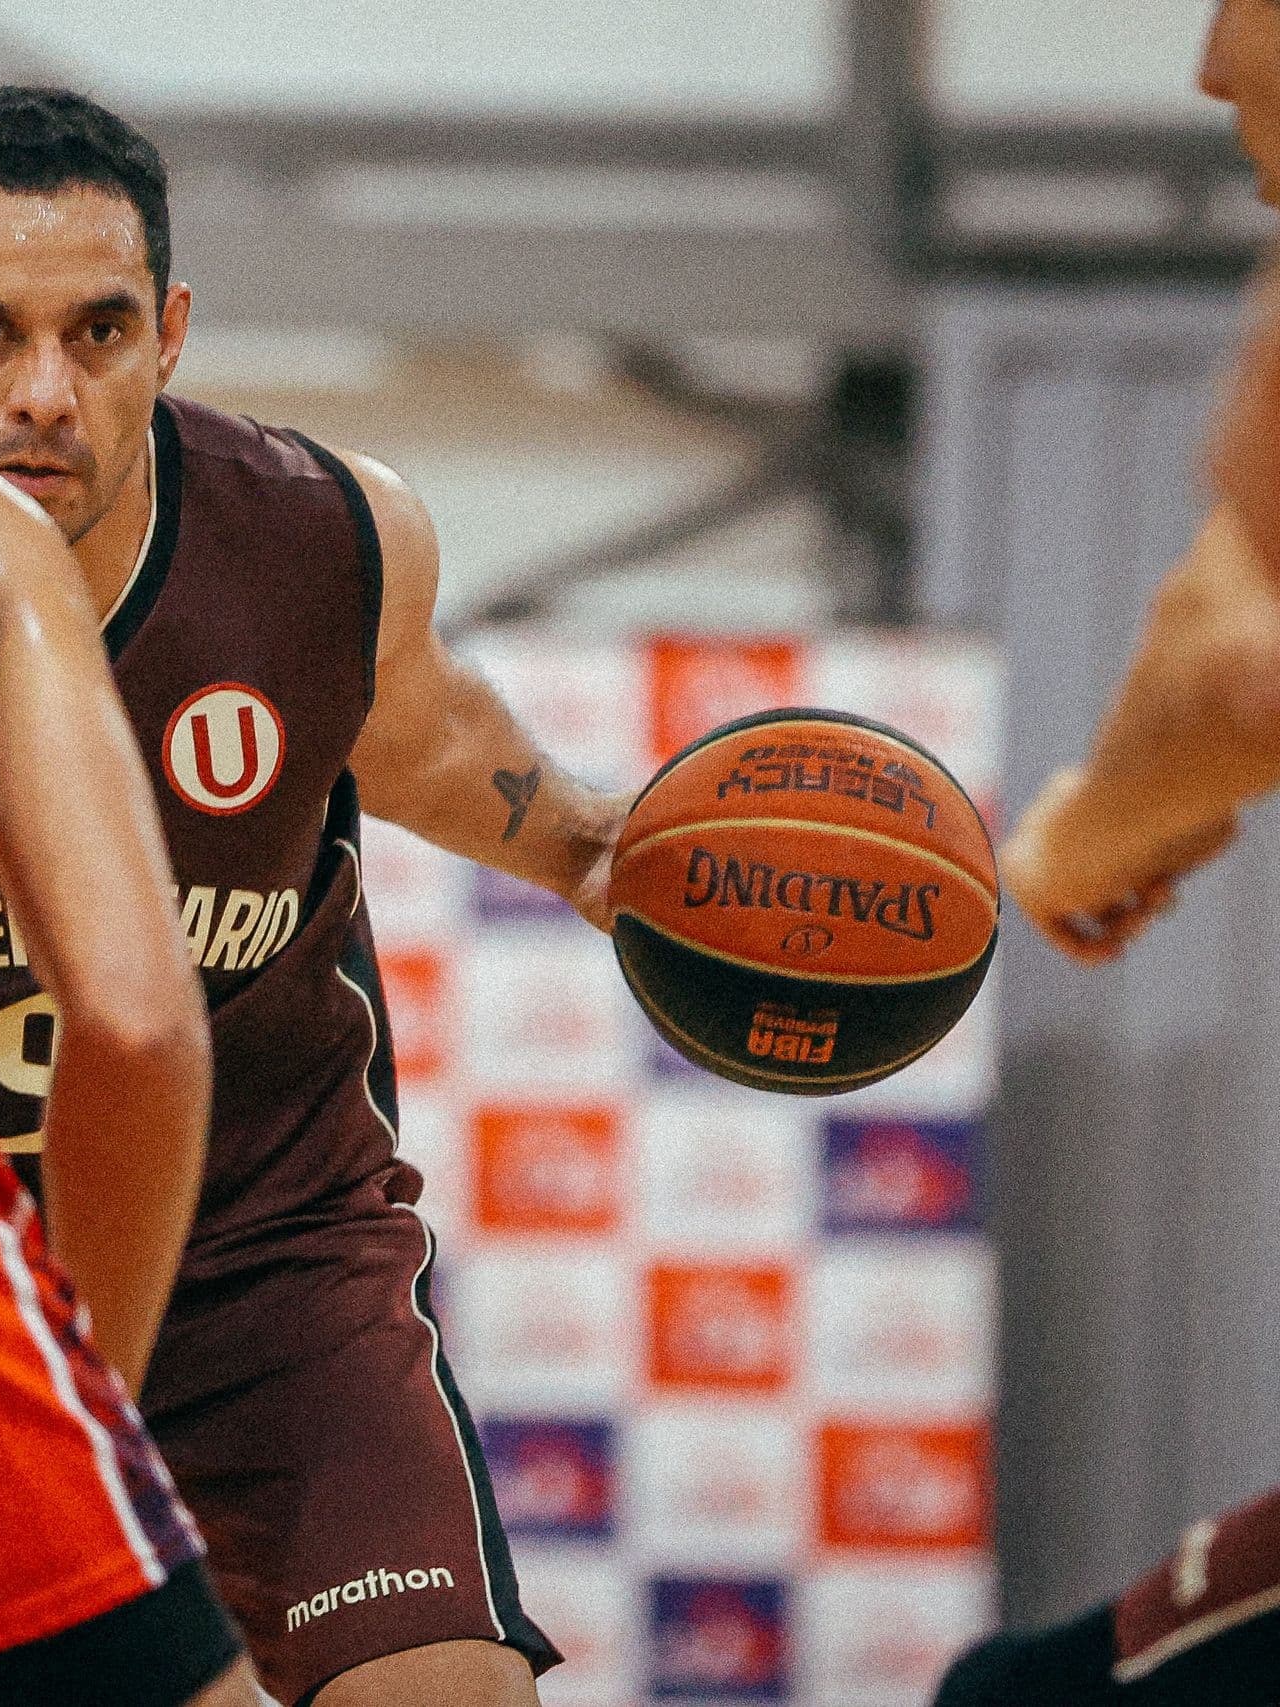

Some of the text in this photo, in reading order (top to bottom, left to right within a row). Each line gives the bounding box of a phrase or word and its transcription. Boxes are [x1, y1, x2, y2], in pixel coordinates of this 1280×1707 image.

[191, 705, 259, 798] U
[717, 762, 936, 830] LEGACY
[683, 847, 940, 942] SPALDING
[747, 1027, 835, 1065] FIBA
[286, 1567, 455, 1633] marathon
